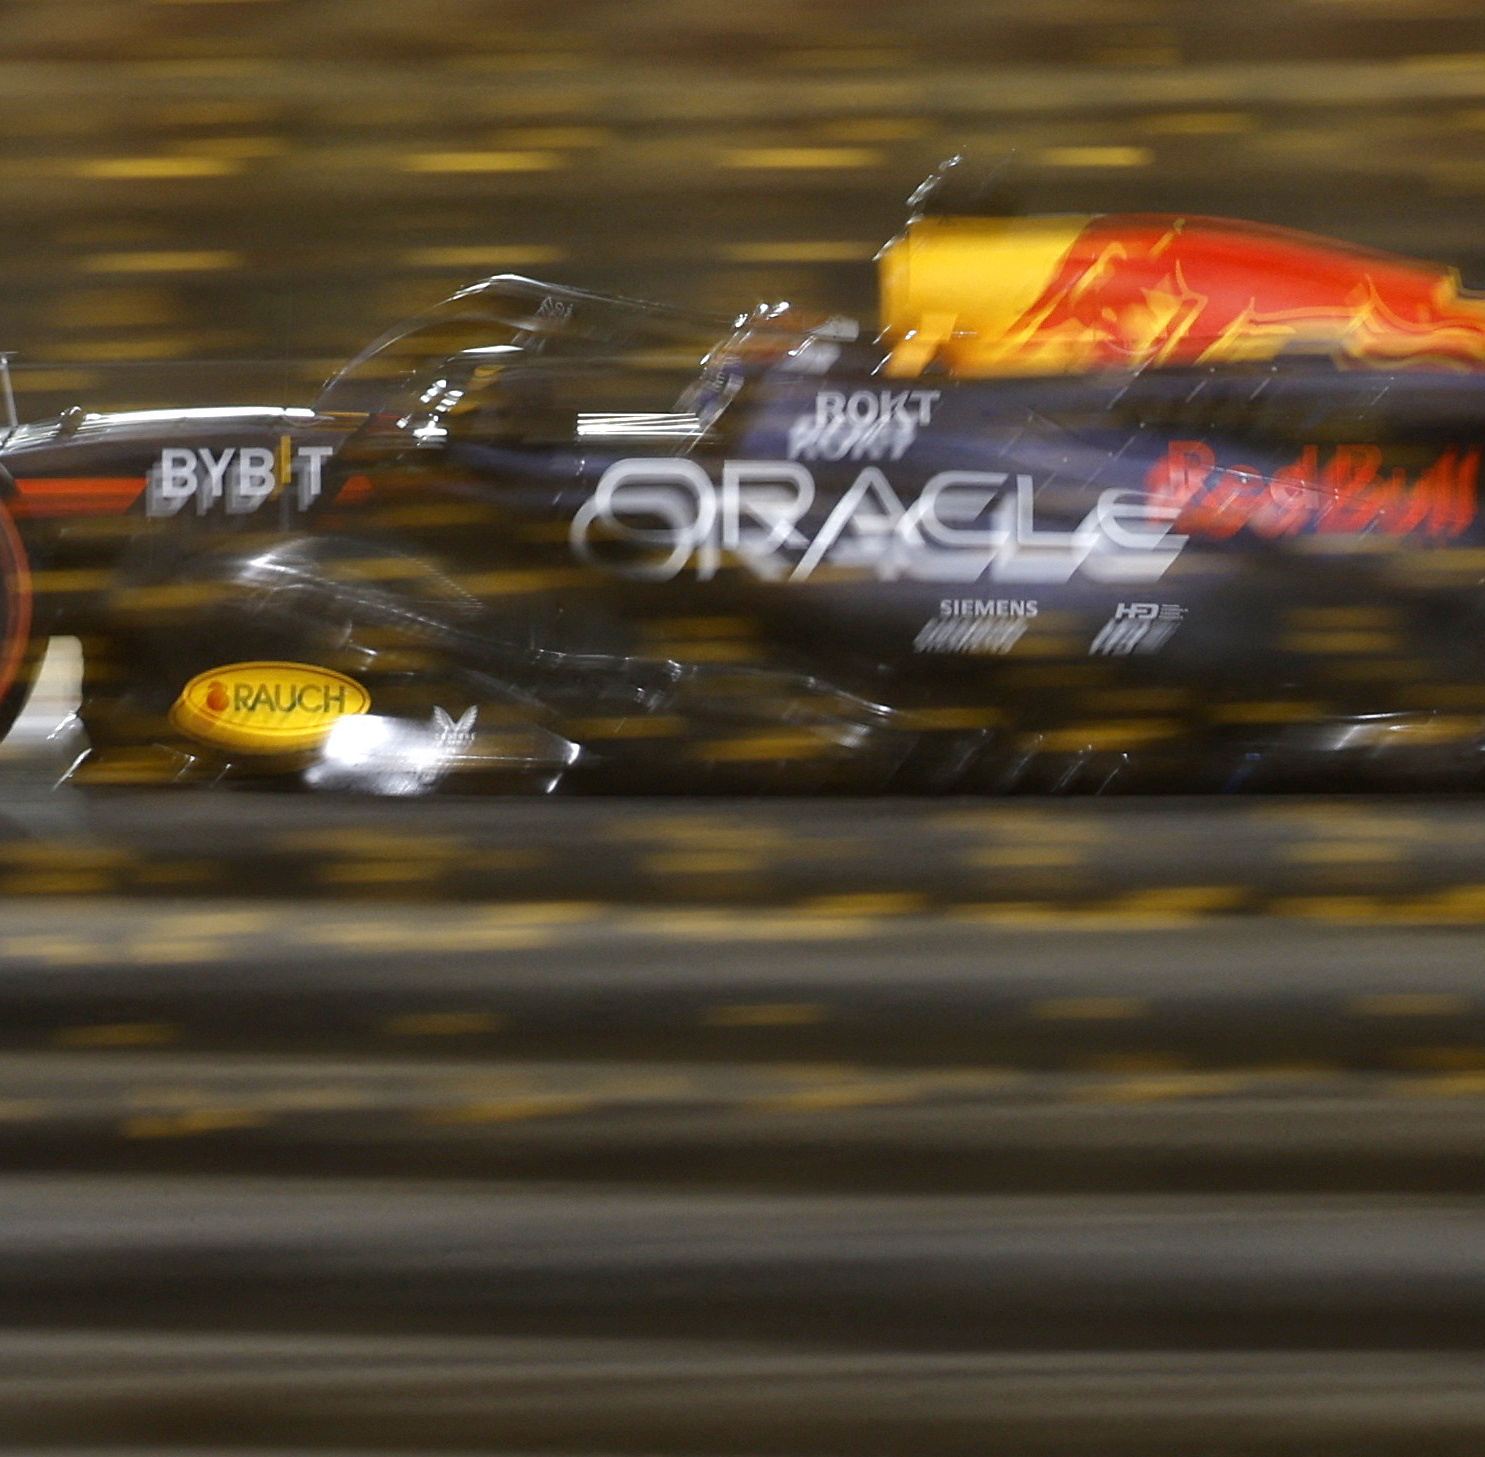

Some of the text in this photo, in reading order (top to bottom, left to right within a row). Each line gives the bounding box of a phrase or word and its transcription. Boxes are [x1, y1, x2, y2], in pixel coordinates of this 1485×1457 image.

[817, 390, 940, 426] ROKT
[160, 436, 334, 498] BYBIT
[590, 457, 1190, 552] ORACLE
[940, 600, 1038, 617] SIEMENS
[233, 683, 346, 714] RAUCH
